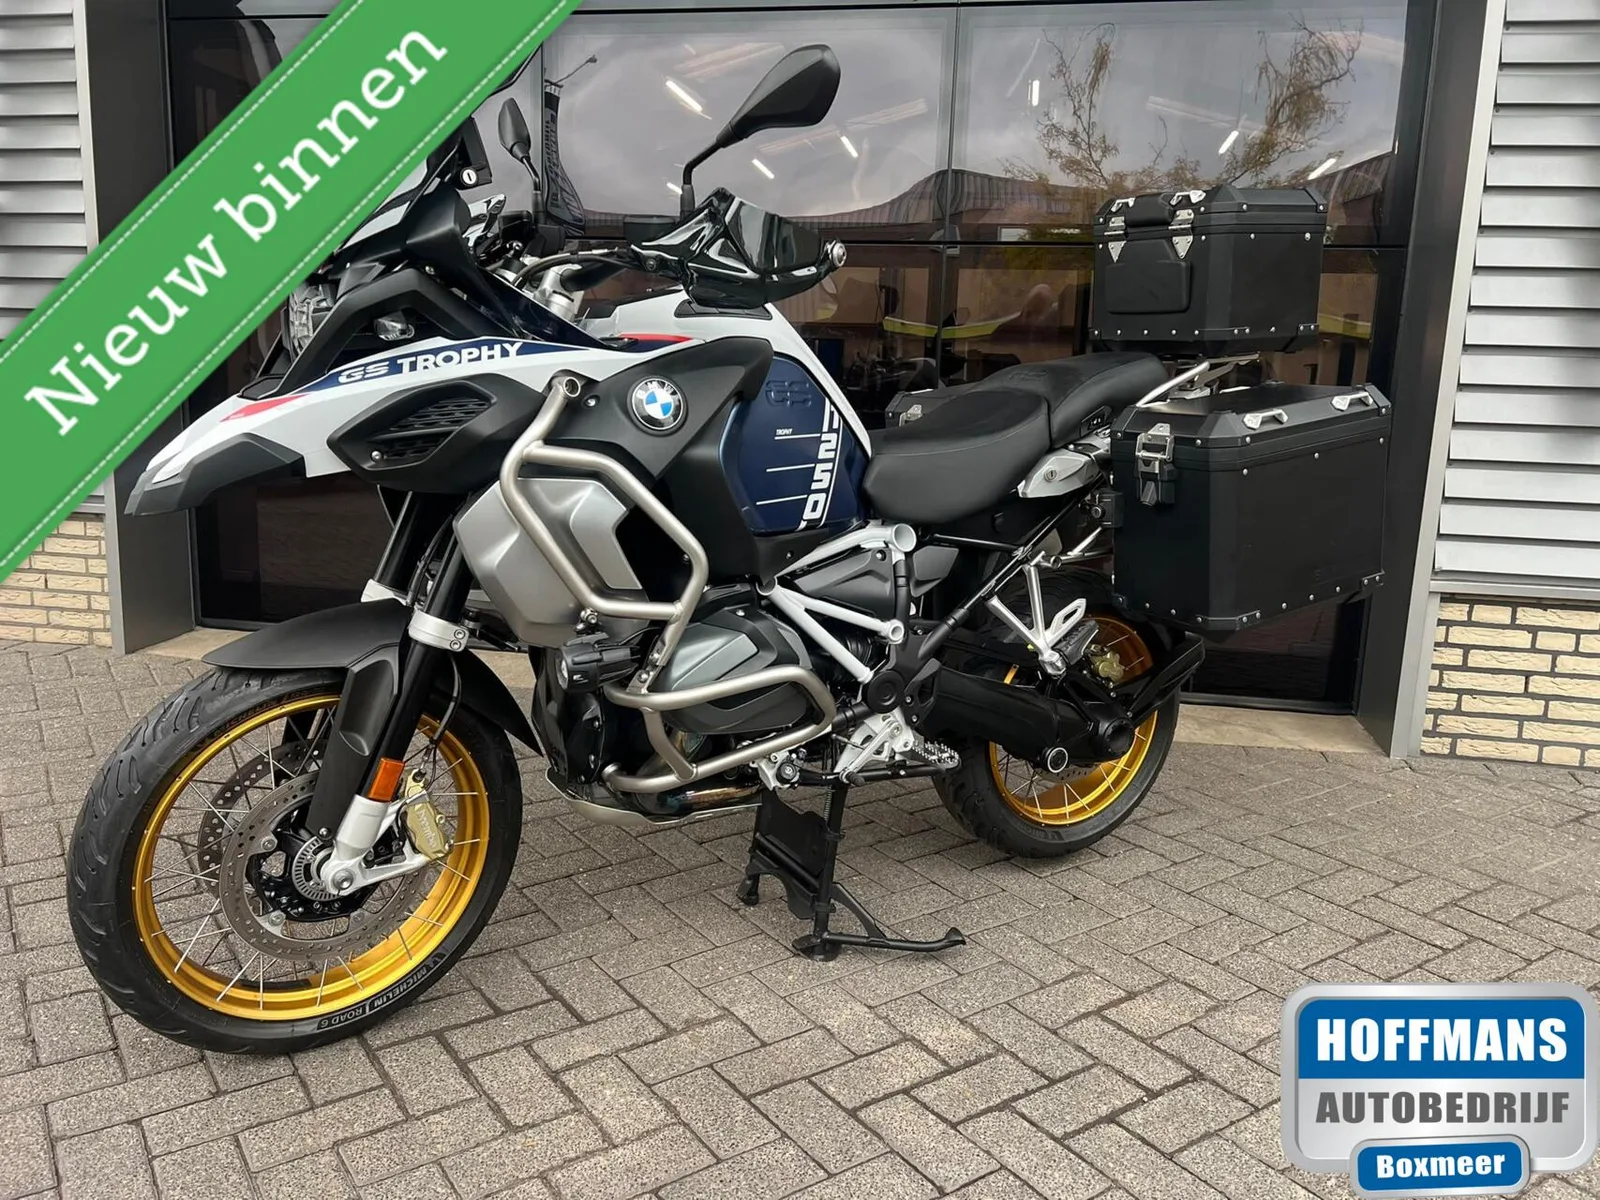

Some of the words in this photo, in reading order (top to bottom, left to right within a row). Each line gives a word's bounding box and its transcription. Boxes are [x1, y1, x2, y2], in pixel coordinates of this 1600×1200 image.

[338, 361, 390, 384] GS
[397, 342, 523, 374] TROPHY
[802, 402, 840, 520] 1250
[374, 966, 427, 1008] MICHELIN
[321, 1019, 329, 1028] 6
[331, 1007, 363, 1025] ROAD
